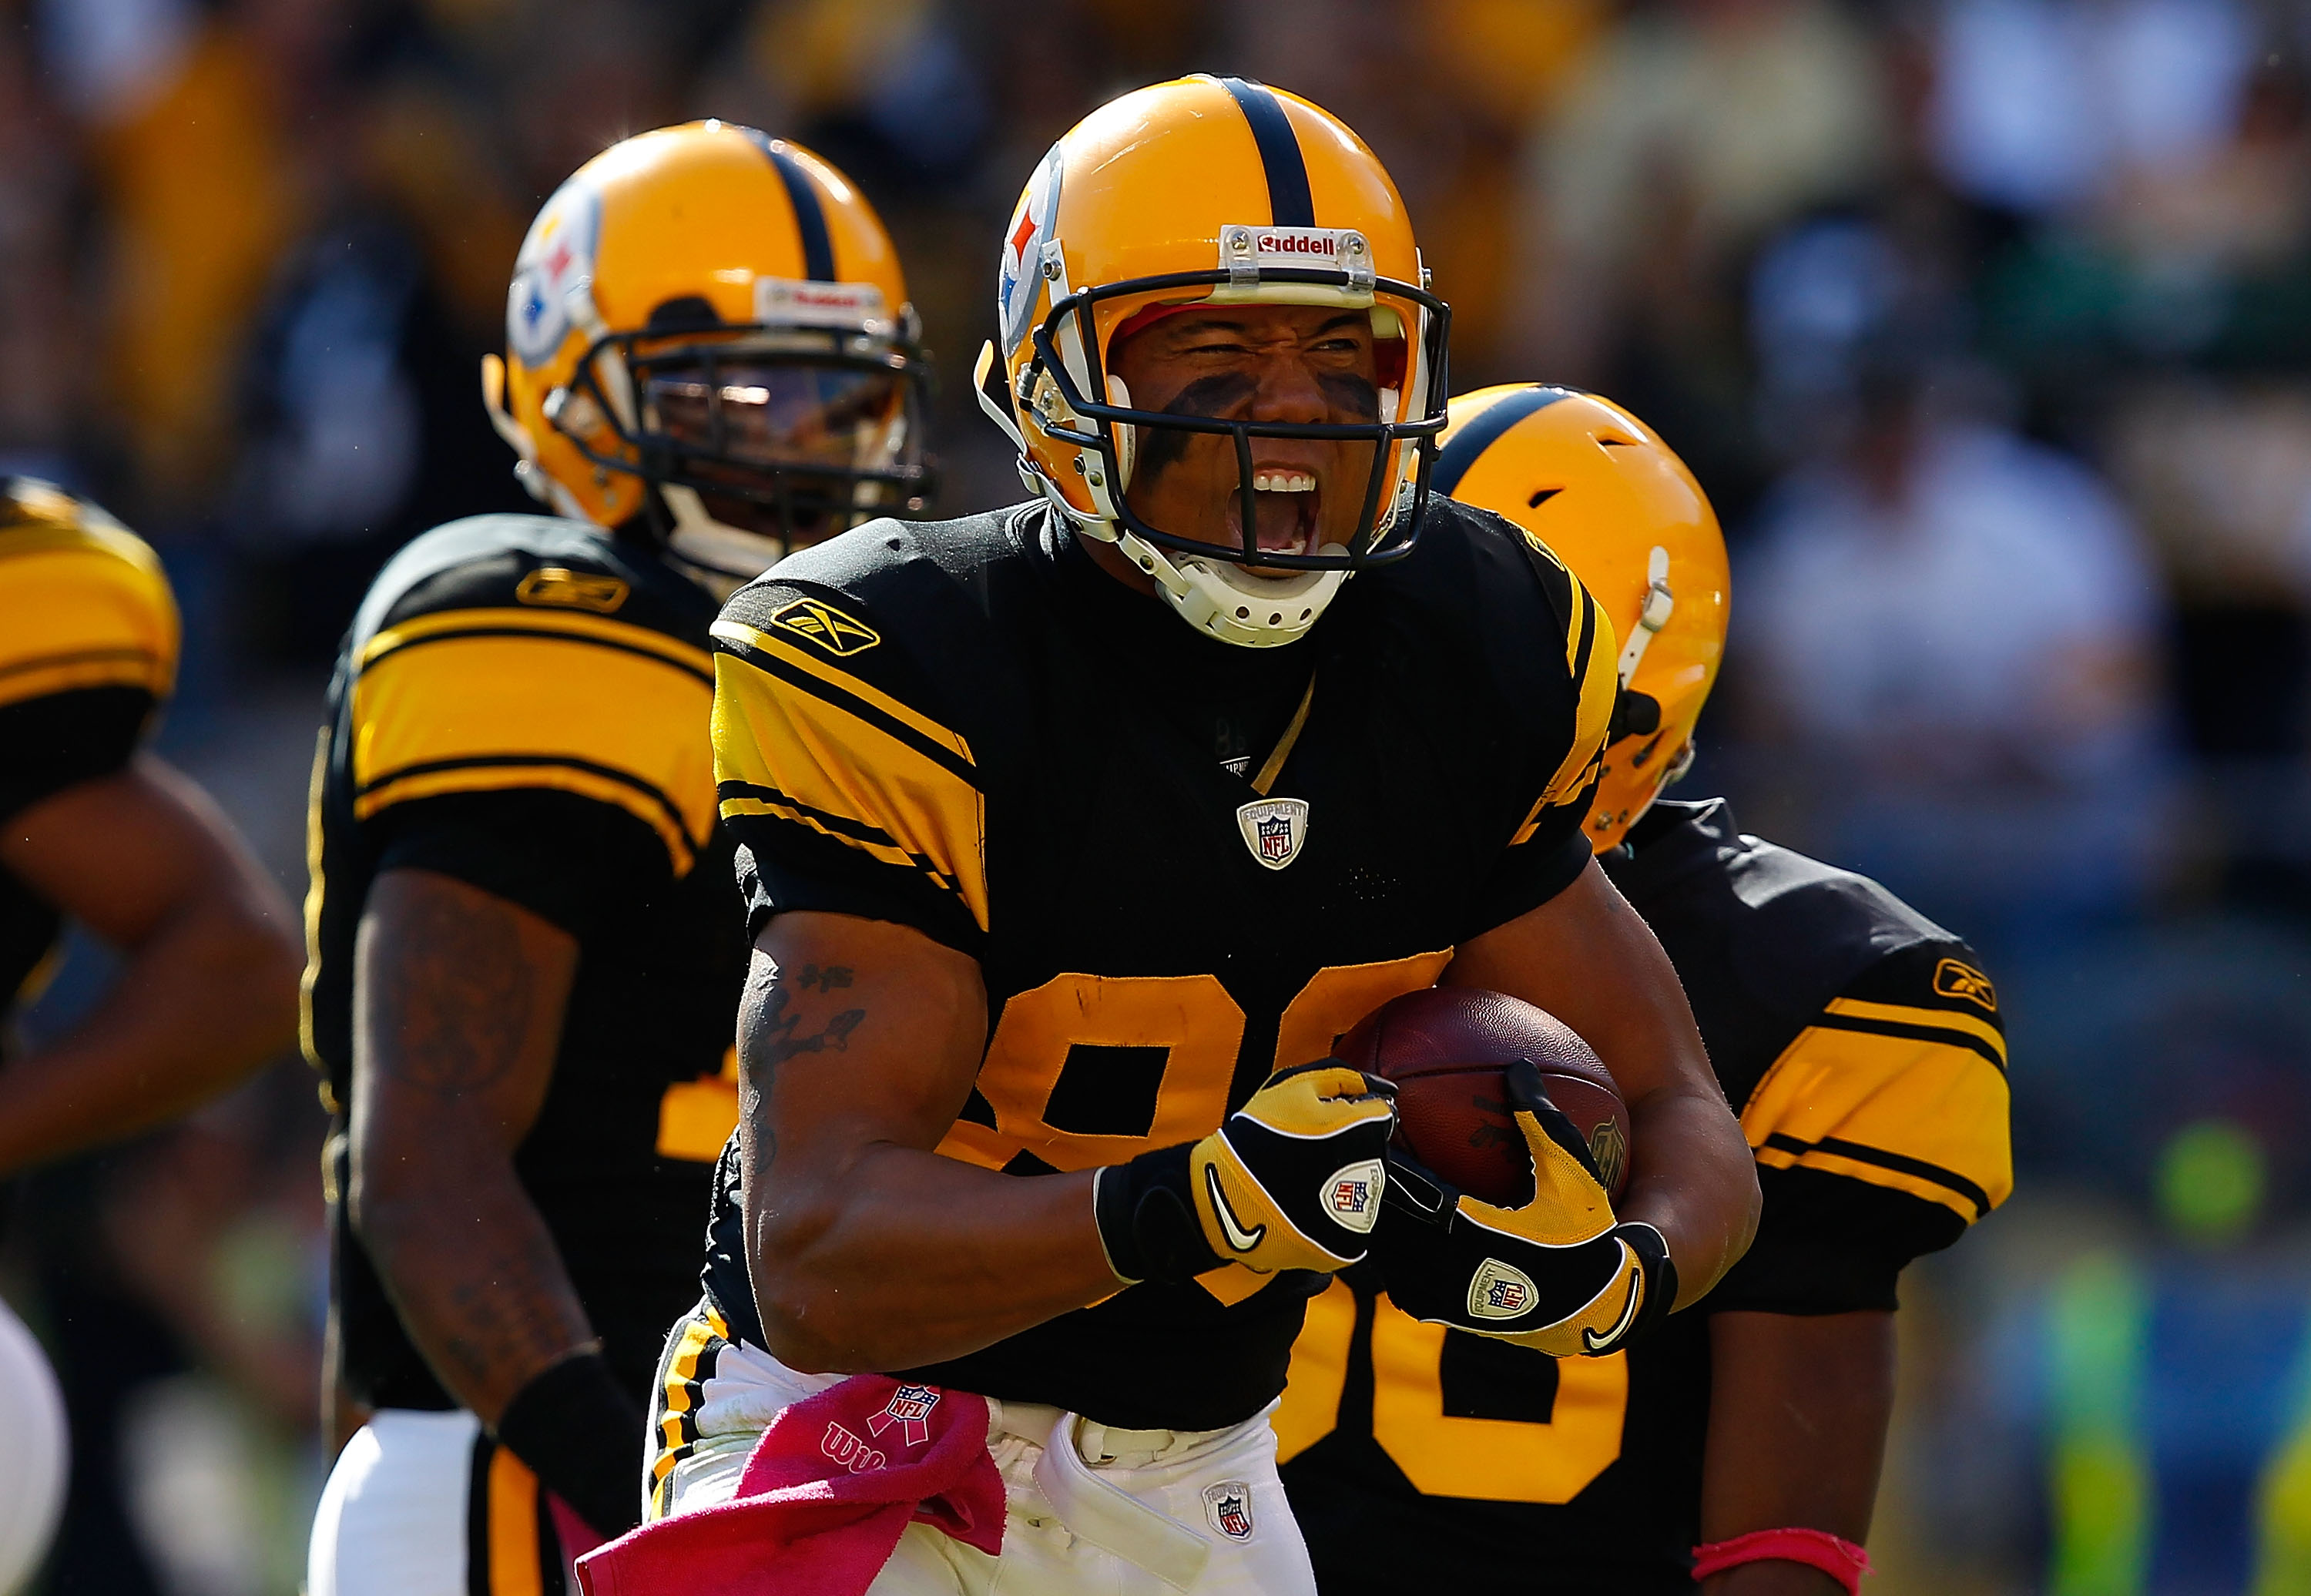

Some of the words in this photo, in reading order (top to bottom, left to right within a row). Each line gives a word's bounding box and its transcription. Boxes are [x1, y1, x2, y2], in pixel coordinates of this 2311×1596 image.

[1257, 235, 1334, 255] Riddell
[1244, 803, 1303, 820] EQUIPMENT
[1263, 836, 1290, 857] NFL
[1336, 1182, 1354, 1210] NFL
[1474, 1268, 1495, 1313] EQUIPMENT
[1502, 1285, 1524, 1308] NFL
[890, 1400, 925, 1417] NFL
[1222, 1514, 1247, 1533] NFL
